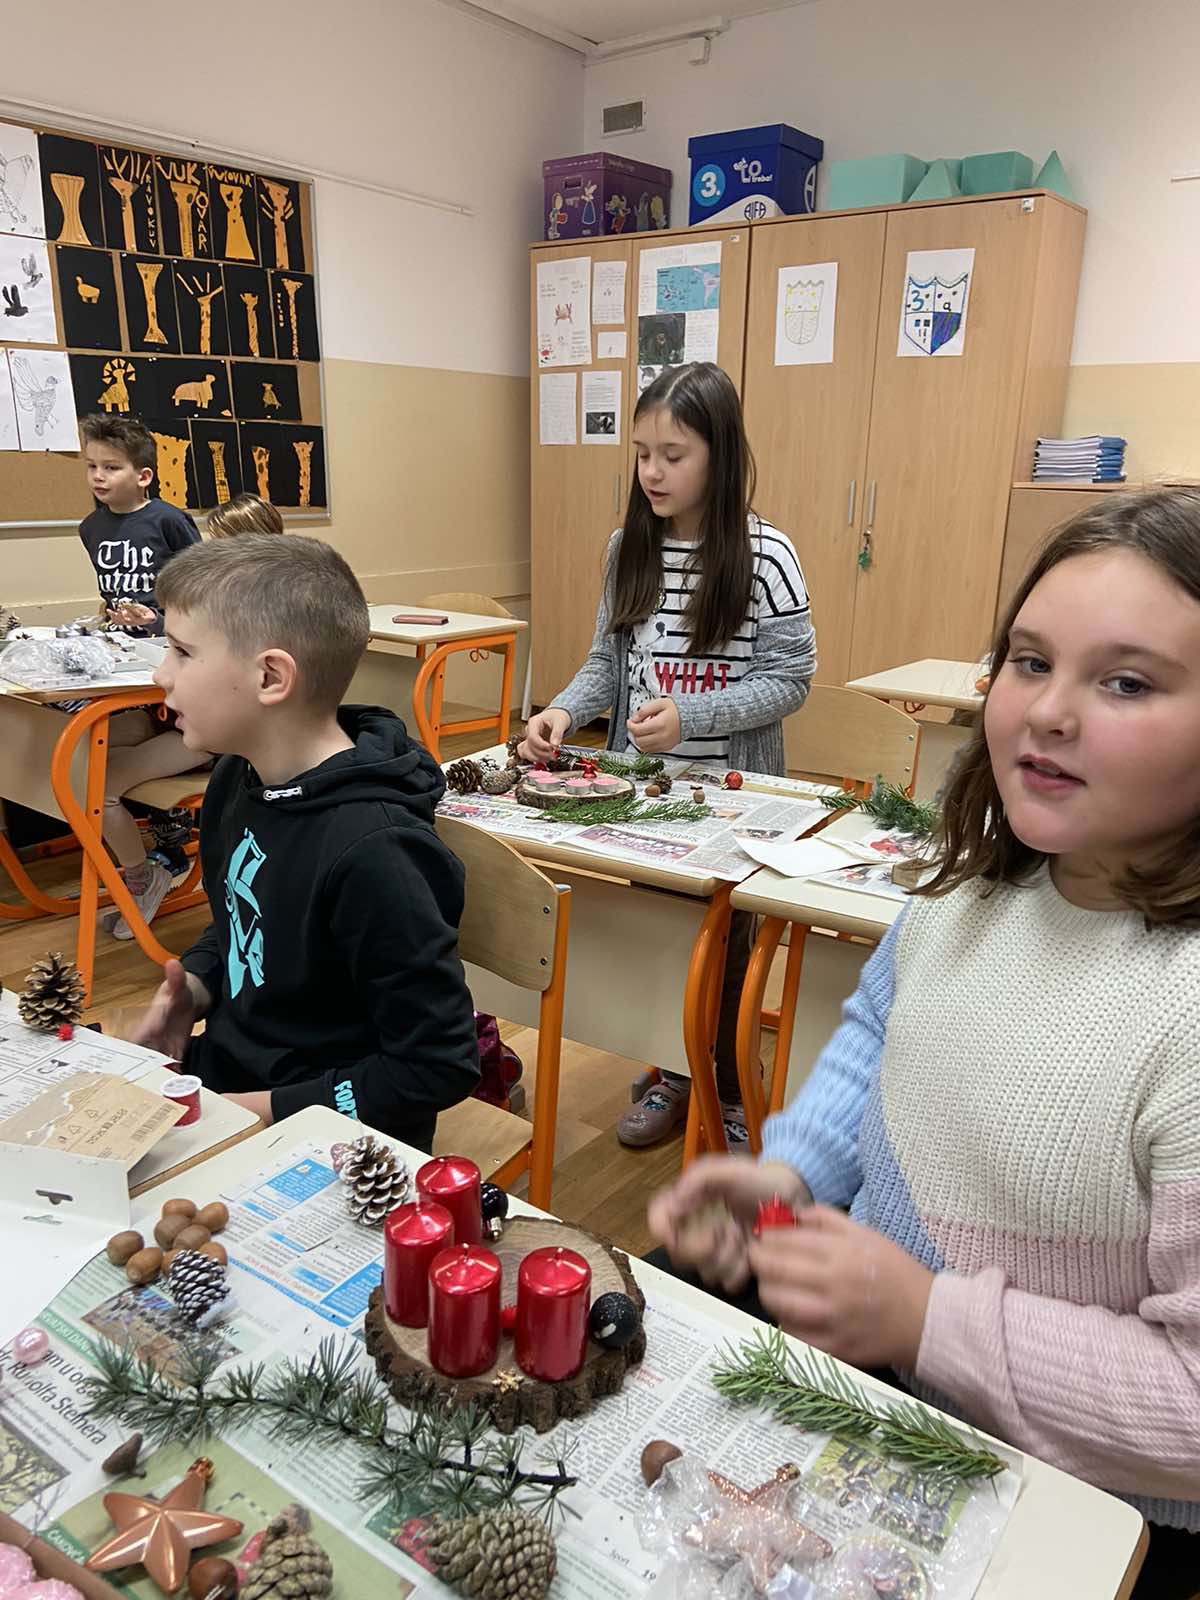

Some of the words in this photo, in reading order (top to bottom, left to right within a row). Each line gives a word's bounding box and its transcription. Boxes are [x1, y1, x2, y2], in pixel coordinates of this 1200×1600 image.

[97, 540, 154, 573] The
[98, 568, 156, 596] utur
[654, 662, 731, 694] WHAT
